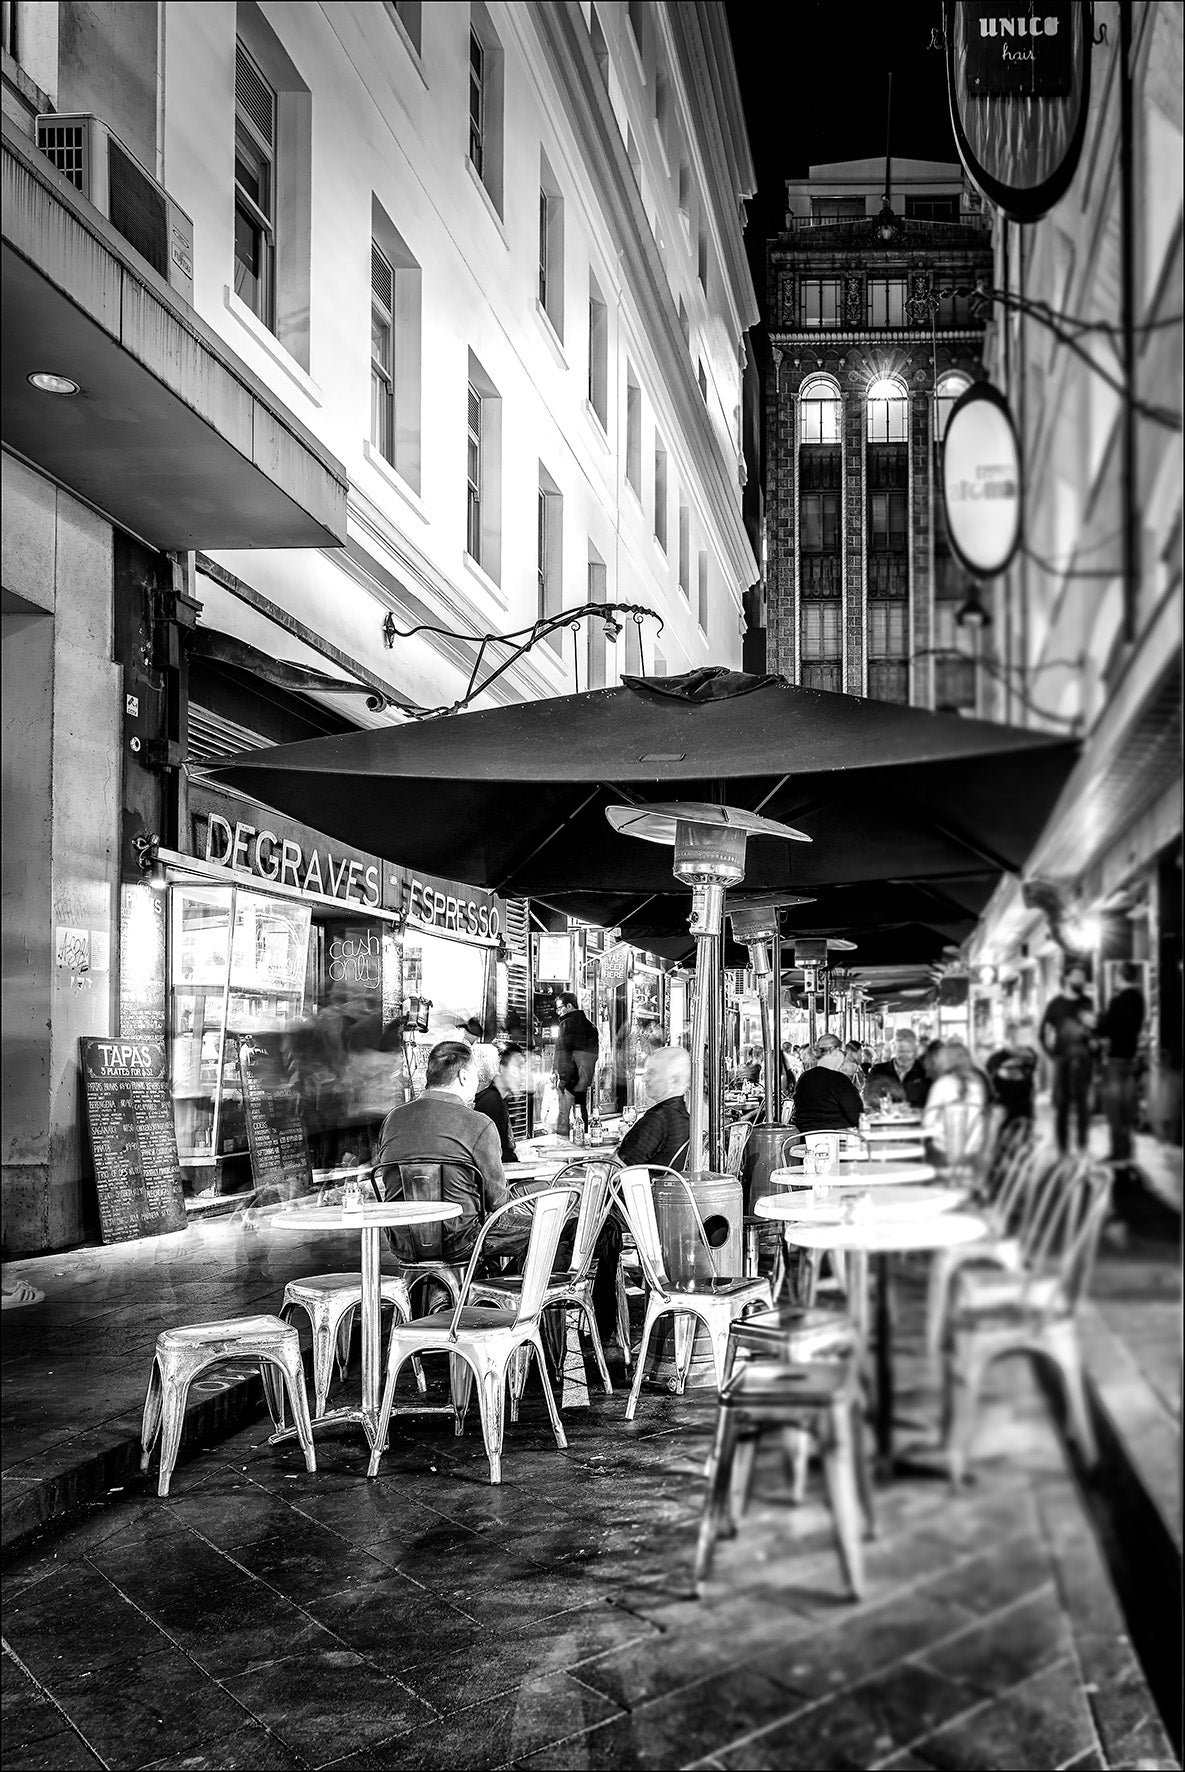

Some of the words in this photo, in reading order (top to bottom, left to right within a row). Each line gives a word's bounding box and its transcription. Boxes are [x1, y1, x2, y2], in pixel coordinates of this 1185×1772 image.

[979, 16, 1059, 37] UNICO
[1002, 42, 1036, 60] hair
[205, 812, 380, 908] DEGRAVES
[408, 878, 500, 940] ESPRESSO
[329, 928, 380, 960] cash
[329, 954, 380, 989] only
[604, 963, 625, 971] BEER
[604, 971, 624, 979] HERE
[97, 1044, 152, 1068] TAPAS
[107, 1067, 130, 1076] PLATES
[131, 1067, 142, 1076] FOR
